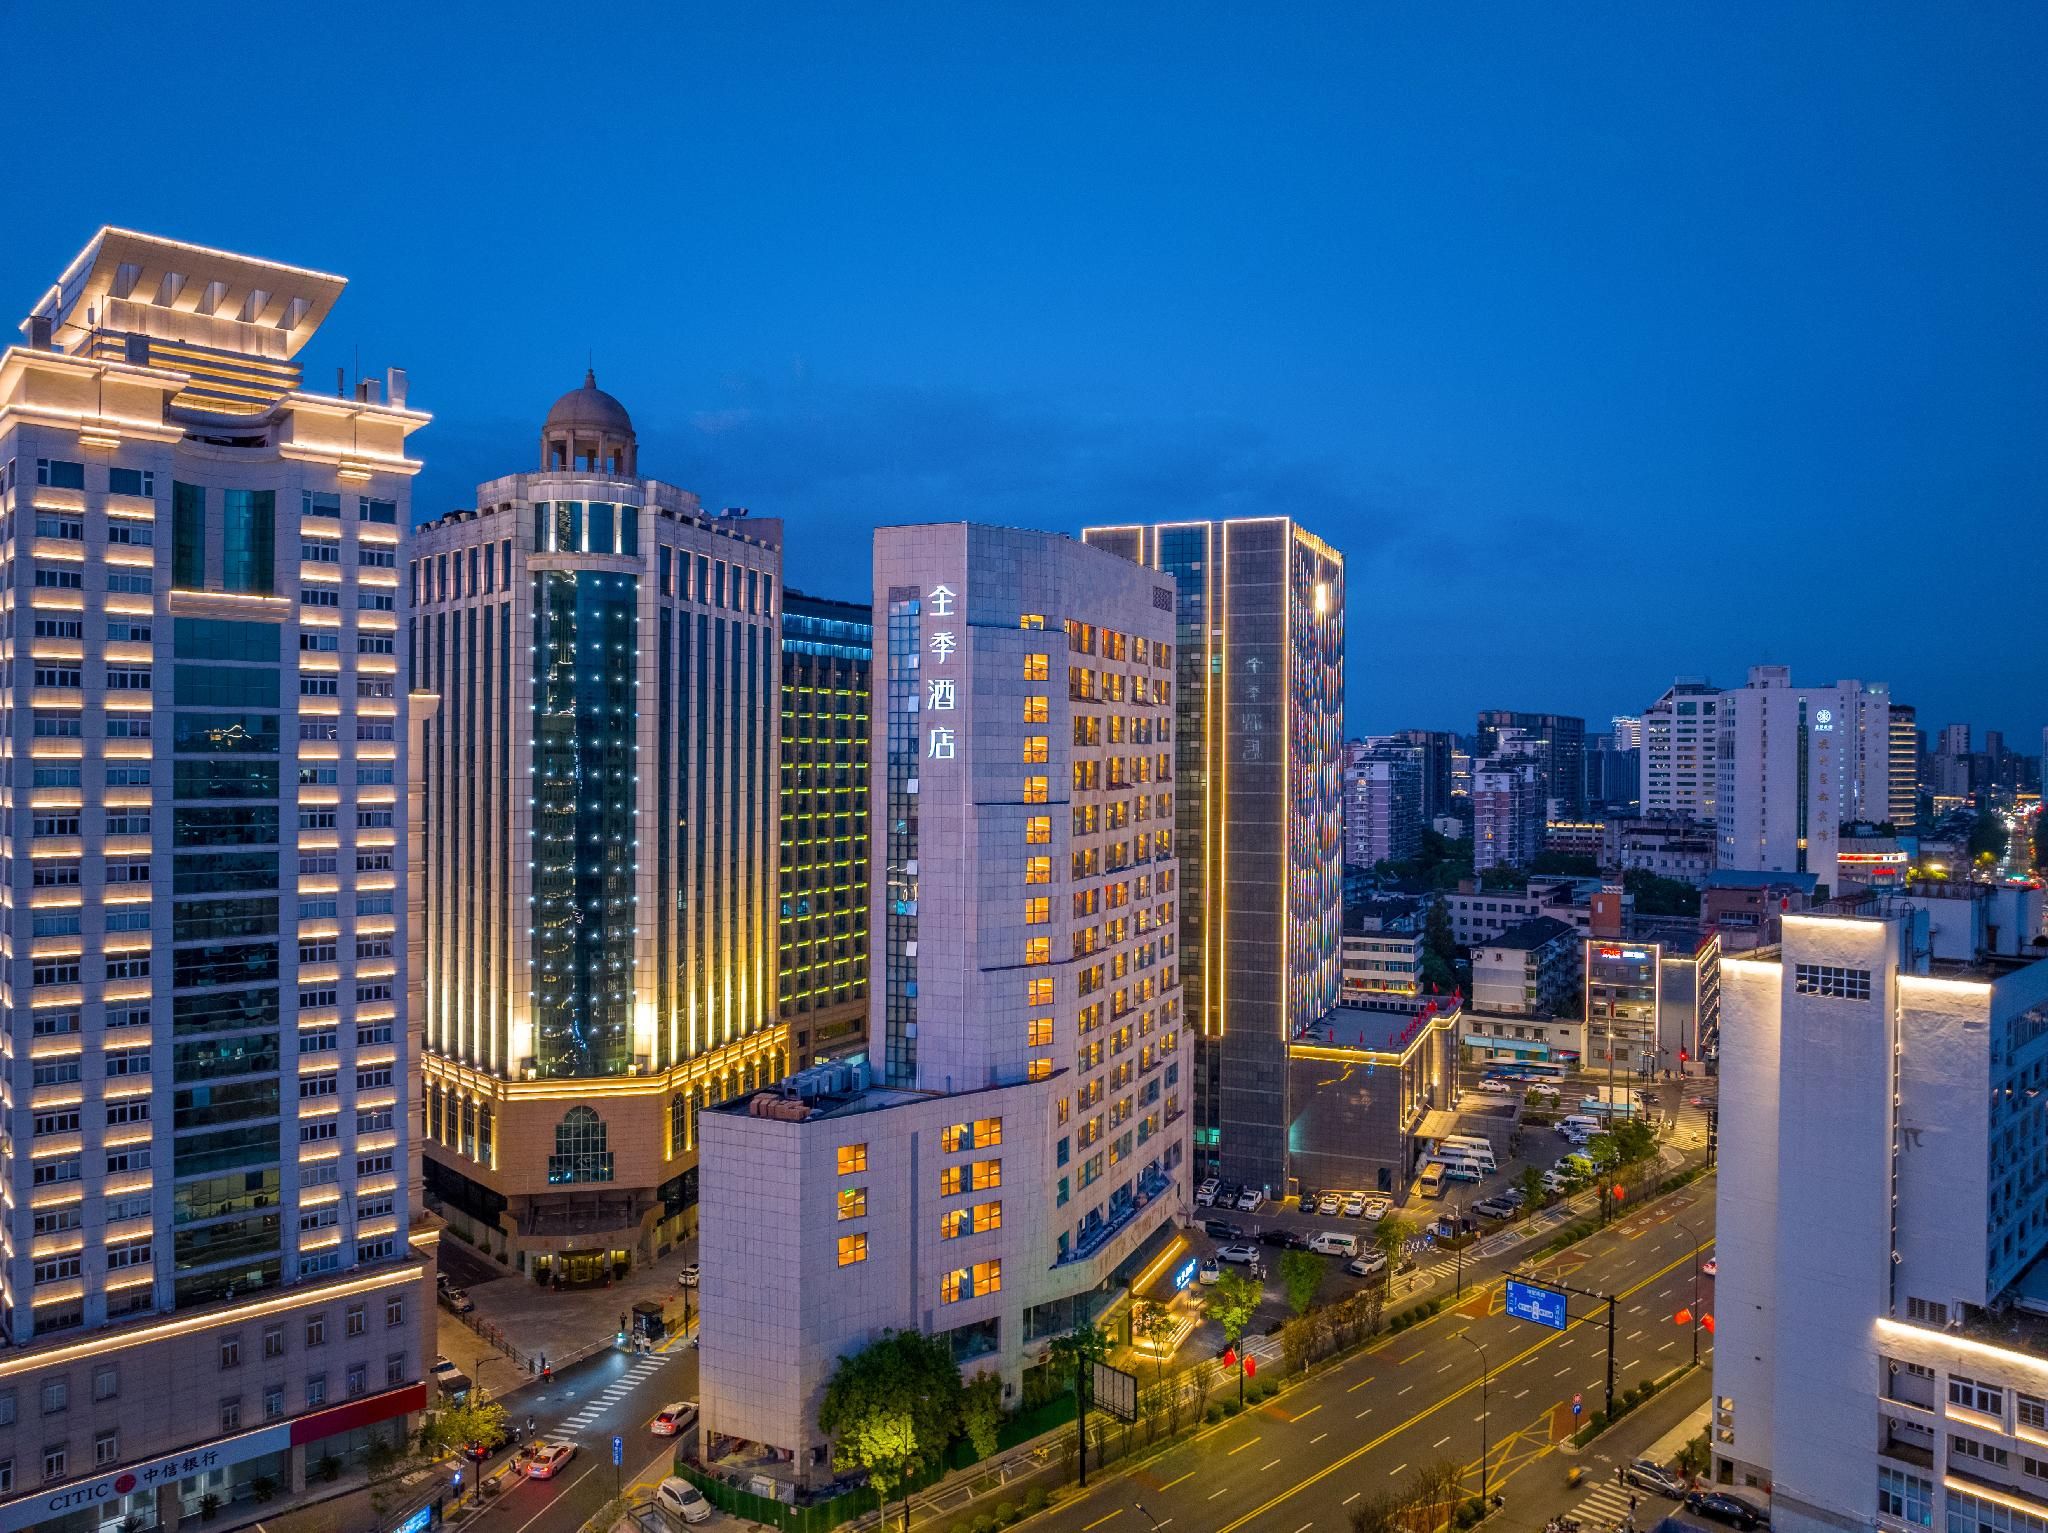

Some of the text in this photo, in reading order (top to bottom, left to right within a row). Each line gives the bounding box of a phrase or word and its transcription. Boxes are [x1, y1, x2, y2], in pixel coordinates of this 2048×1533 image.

[928, 585, 957, 759] 全季酒店
[48, 1450, 219, 1511] CITIC 中信银行
